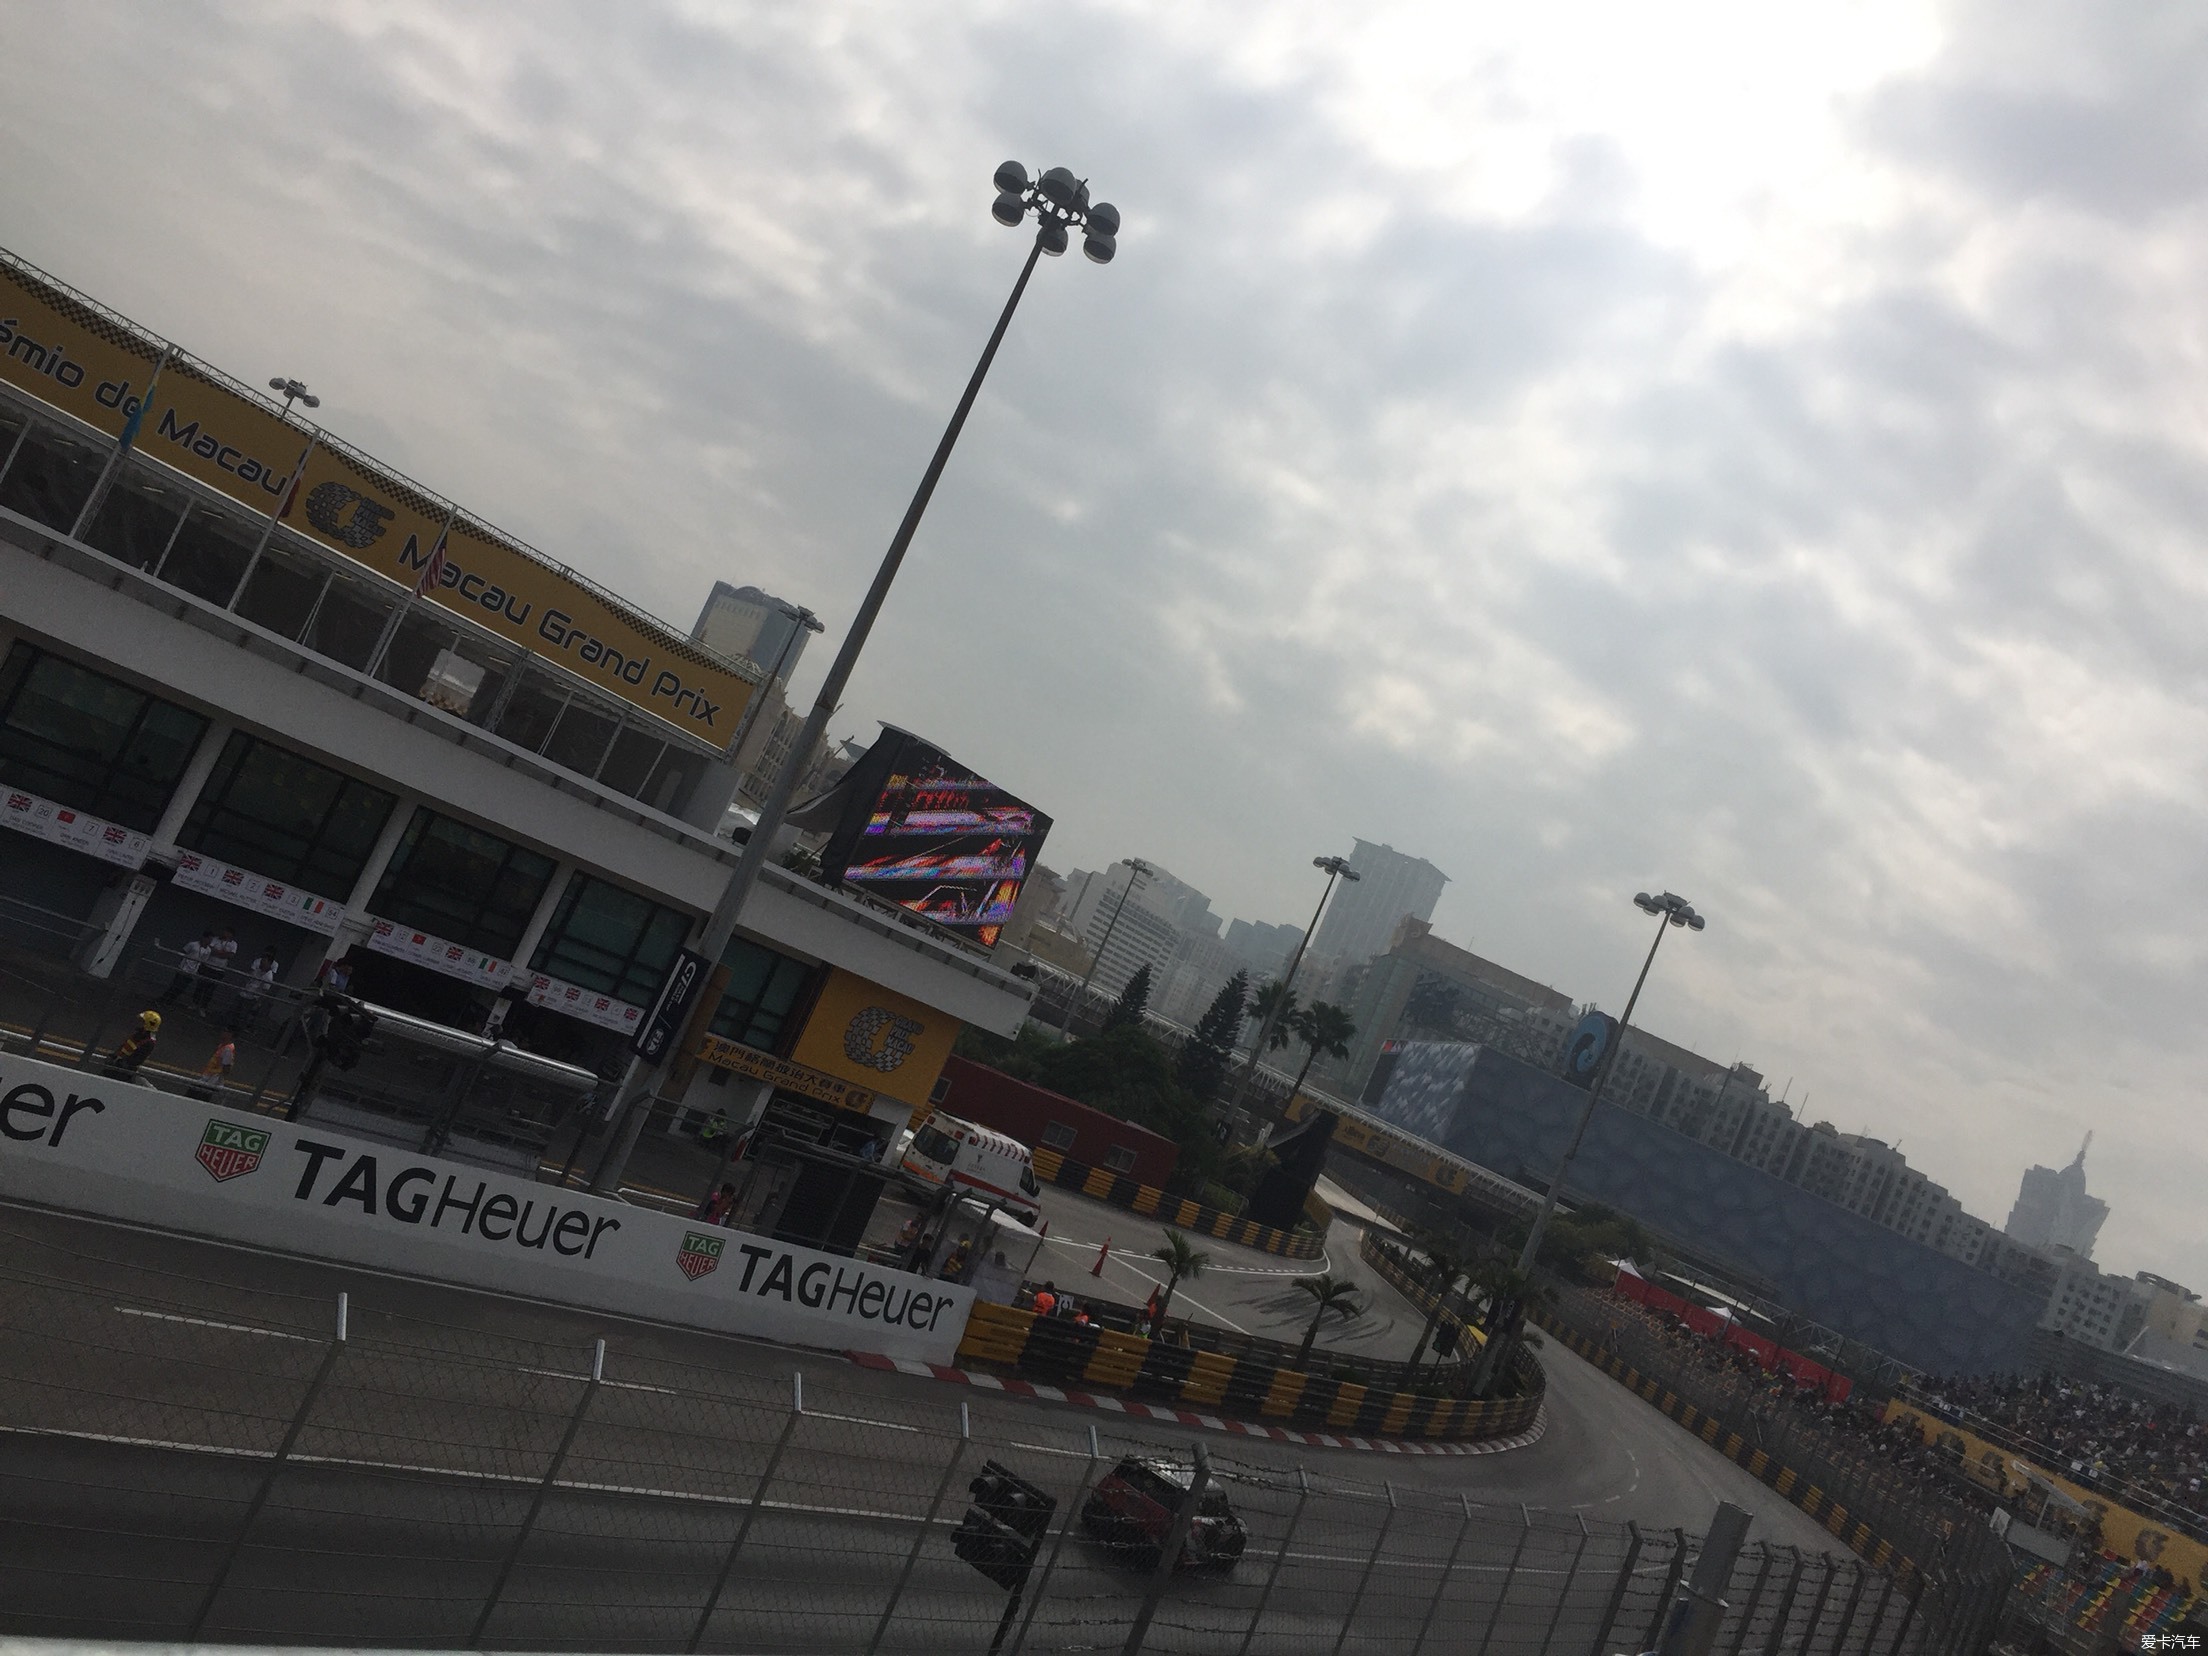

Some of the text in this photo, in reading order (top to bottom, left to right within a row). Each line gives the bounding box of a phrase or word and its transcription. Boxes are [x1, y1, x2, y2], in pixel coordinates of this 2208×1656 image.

[157, 408, 288, 496] Macau
[398, 534, 722, 727] Macau Grand Prix
[708, 1052, 841, 1105] Macau Grand Prix
[0, 1077, 105, 1148] er
[213, 1125, 262, 1151] TAG
[201, 1146, 256, 1177] HEUER
[680, 1252, 716, 1276] HEUER
[689, 1236, 719, 1255] TAG
